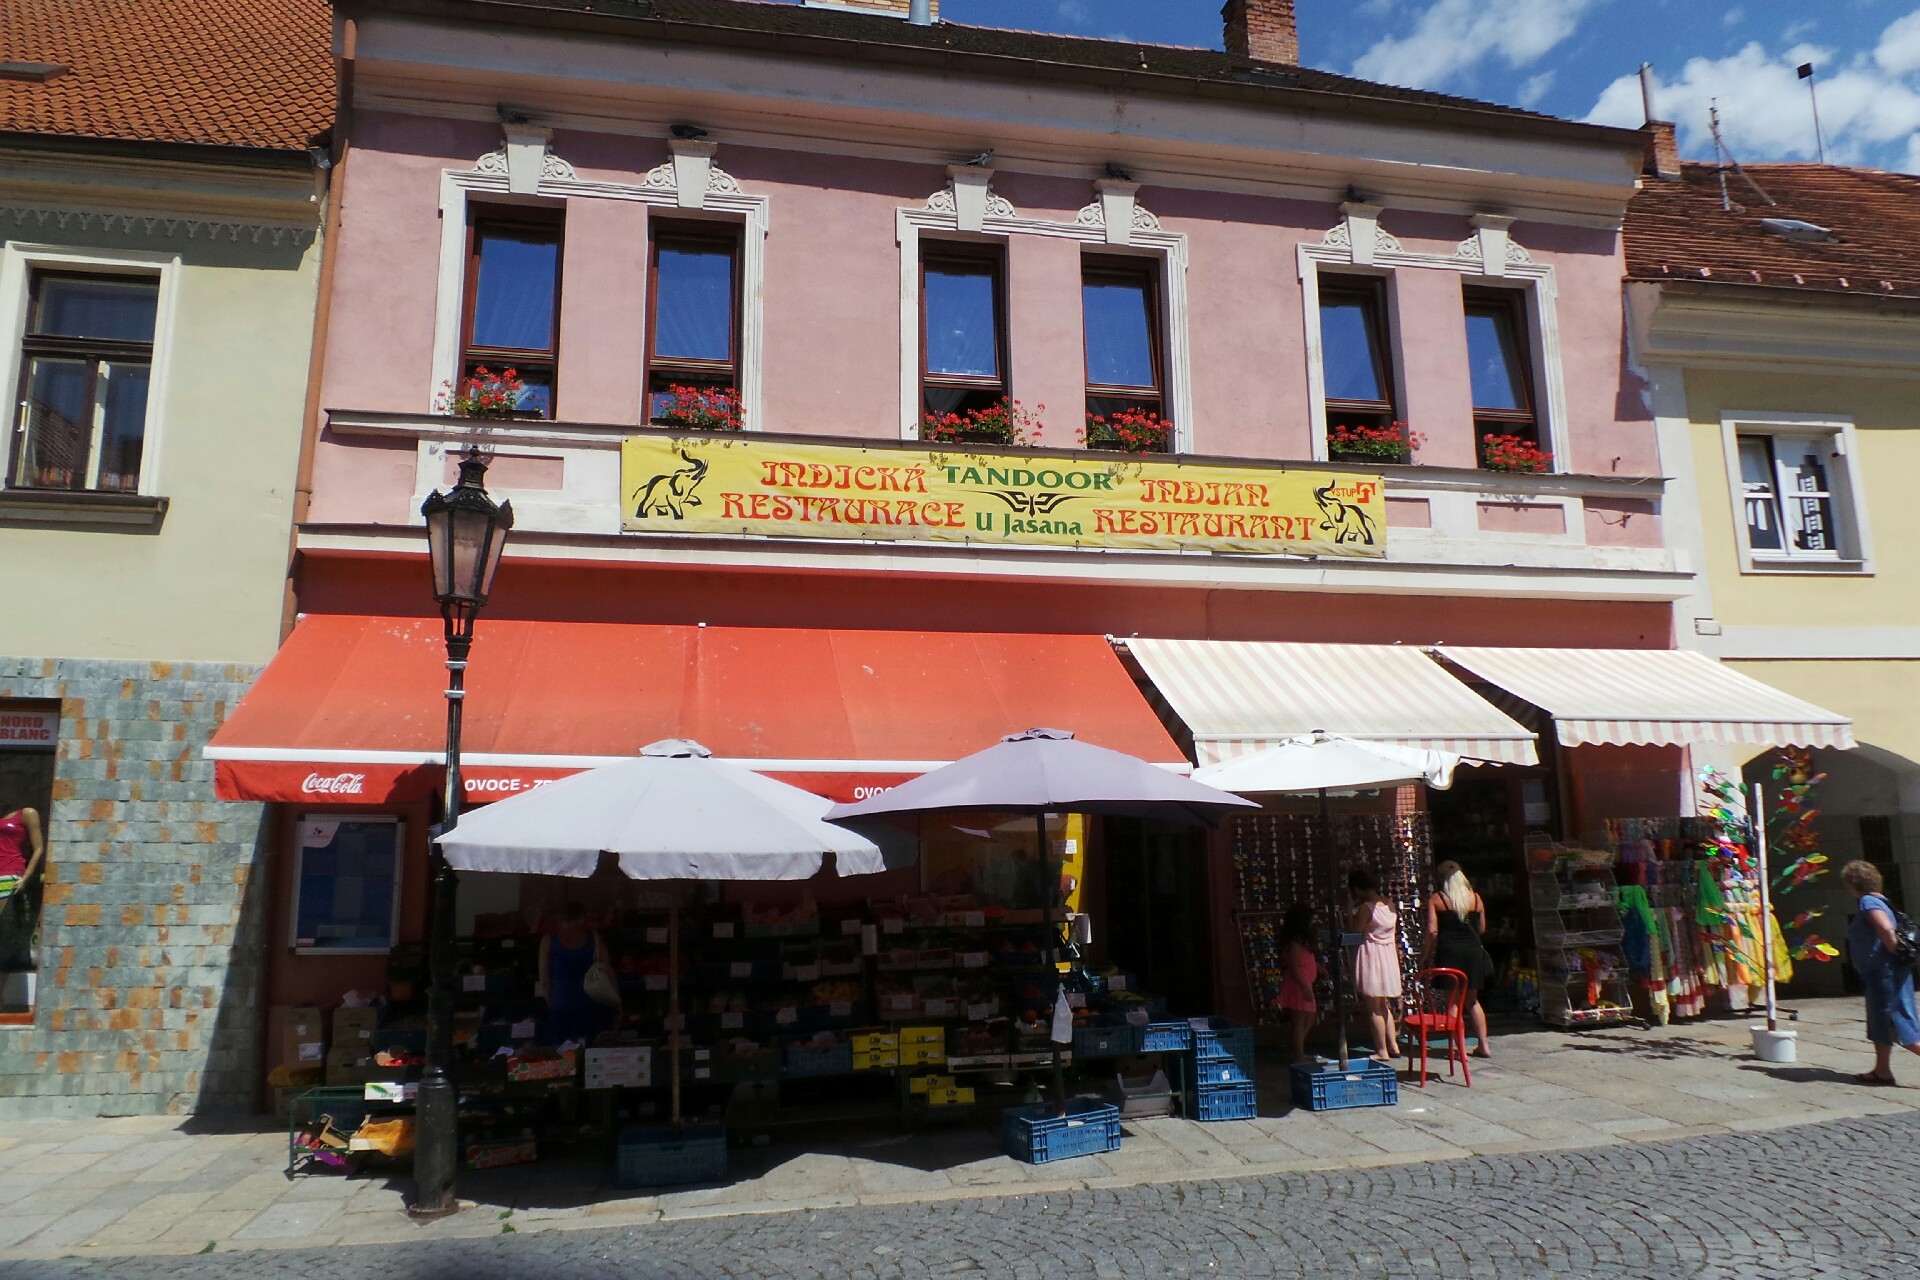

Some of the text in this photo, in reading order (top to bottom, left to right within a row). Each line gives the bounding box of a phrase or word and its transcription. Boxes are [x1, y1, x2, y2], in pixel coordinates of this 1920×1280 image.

[760, 461, 928, 493] INDICKÁ
[942, 465, 1114, 490] TANDOOR
[1139, 479, 1270, 507] INDIAN
[1330, 487, 1357, 497] VSTUP
[719, 492, 966, 527] RESTAURACE
[1003, 513, 1083, 537] Jasana
[1092, 508, 1317, 541] RESTAURANT
[0, 716, 44, 727] NORD
[0, 728, 49, 740] BLANC
[302, 772, 366, 794] Coca-Cola
[464, 778, 521, 792] OVOCE
